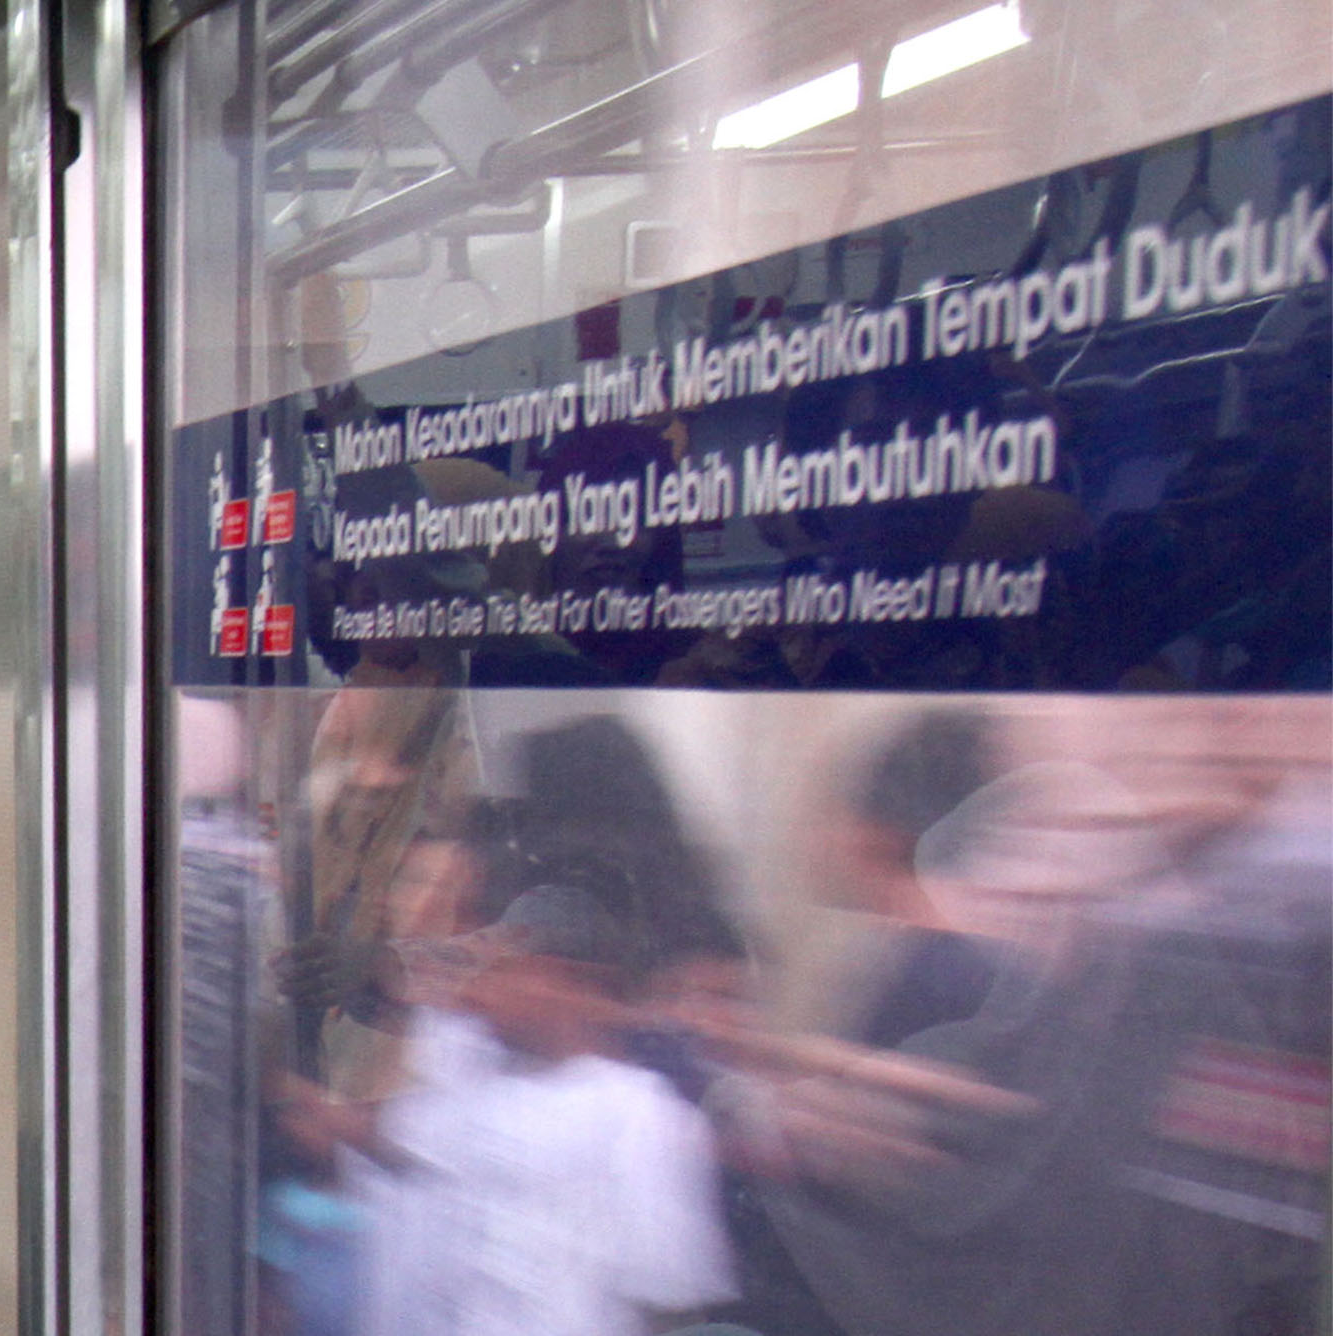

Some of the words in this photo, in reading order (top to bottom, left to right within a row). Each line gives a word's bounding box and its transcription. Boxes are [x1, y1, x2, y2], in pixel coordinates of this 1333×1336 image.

[335, 418, 402, 476] Mohon
[406, 382, 577, 464] Kesadarannya
[583, 349, 668, 427] Untuk
[672, 301, 908, 409] Memberikan
[922, 236, 1112, 361] Tempat
[1122, 185, 1330, 320] Duduk
[334, 503, 411, 571] Kepada
[415, 490, 560, 559] Penumpang
[564, 473, 638, 548] Yang
[645, 449, 733, 527] Lebih
[743, 407, 1055, 516] Membutuhkan
[560, 588, 592, 633] For
[593, 586, 652, 632] Other
[653, 583, 781, 639] Passengers
[786, 573, 847, 624] Who
[848, 566, 935, 622] Need
[961, 557, 1047, 618] Most
